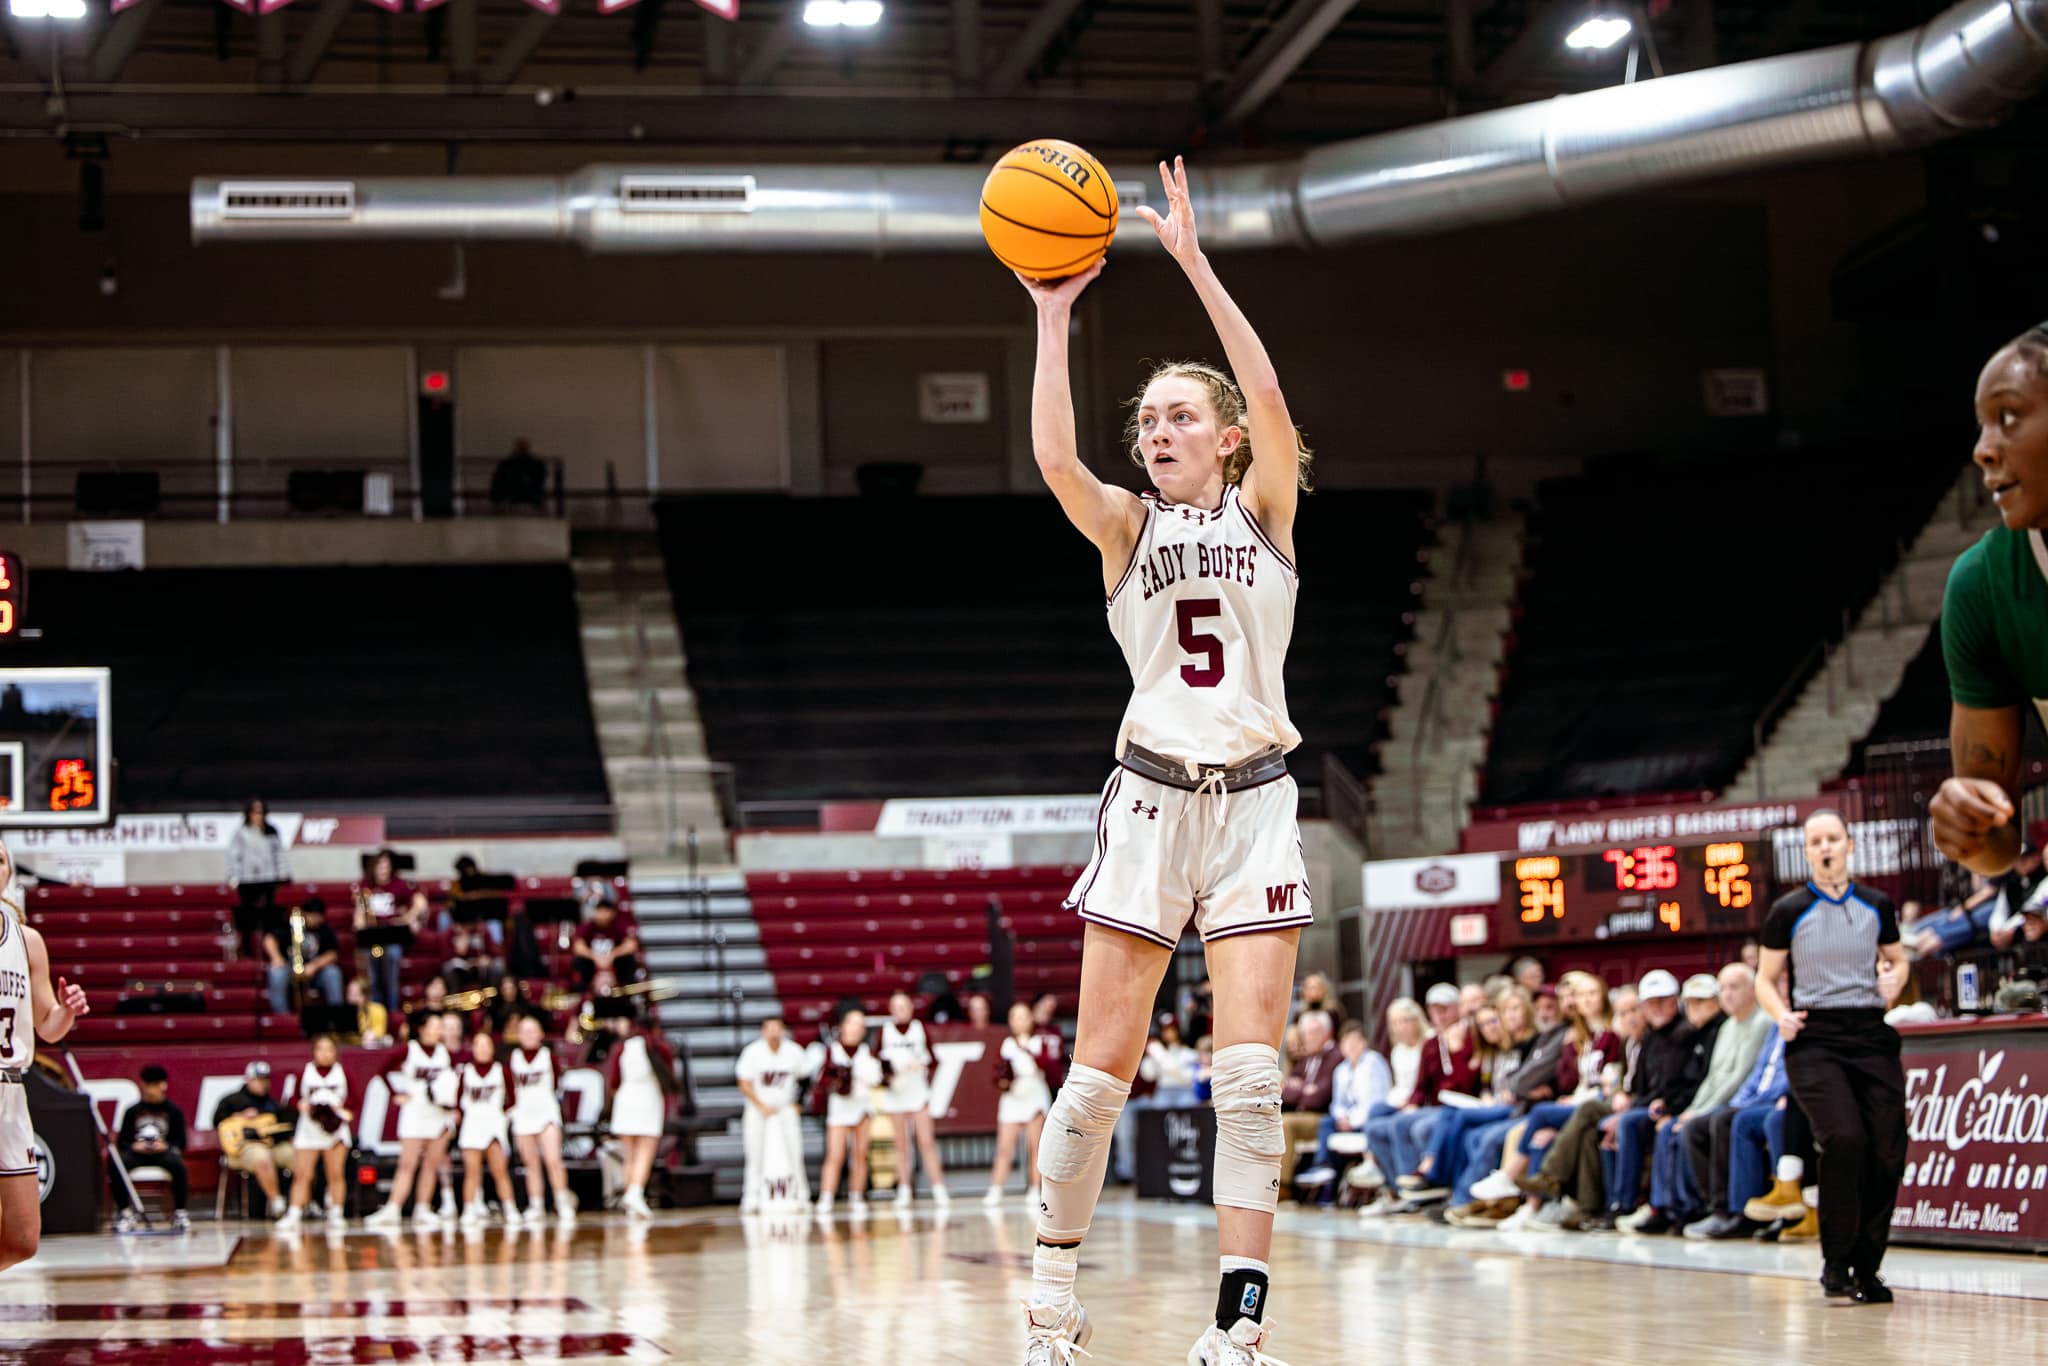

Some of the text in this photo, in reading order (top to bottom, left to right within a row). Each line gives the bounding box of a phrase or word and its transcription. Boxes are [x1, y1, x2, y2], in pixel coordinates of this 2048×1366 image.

[1140, 541, 1257, 601] LADY BUFFS
[1175, 598, 1226, 688] 5
[66, 821, 218, 846] CHAMPIONS
[1555, 821, 1606, 847] LADY
[1607, 814, 1674, 842] BUFFS
[1675, 805, 1797, 837] BASKETBALL
[1266, 883, 1298, 913] WT
[1520, 879, 1565, 923] 34
[1704, 863, 1752, 909] 45
[1659, 902, 1680, 932] 4
[0, 970, 26, 999] UFFS
[1902, 1151, 2048, 1191] edit union
[1948, 1200, 1981, 1231] Live
